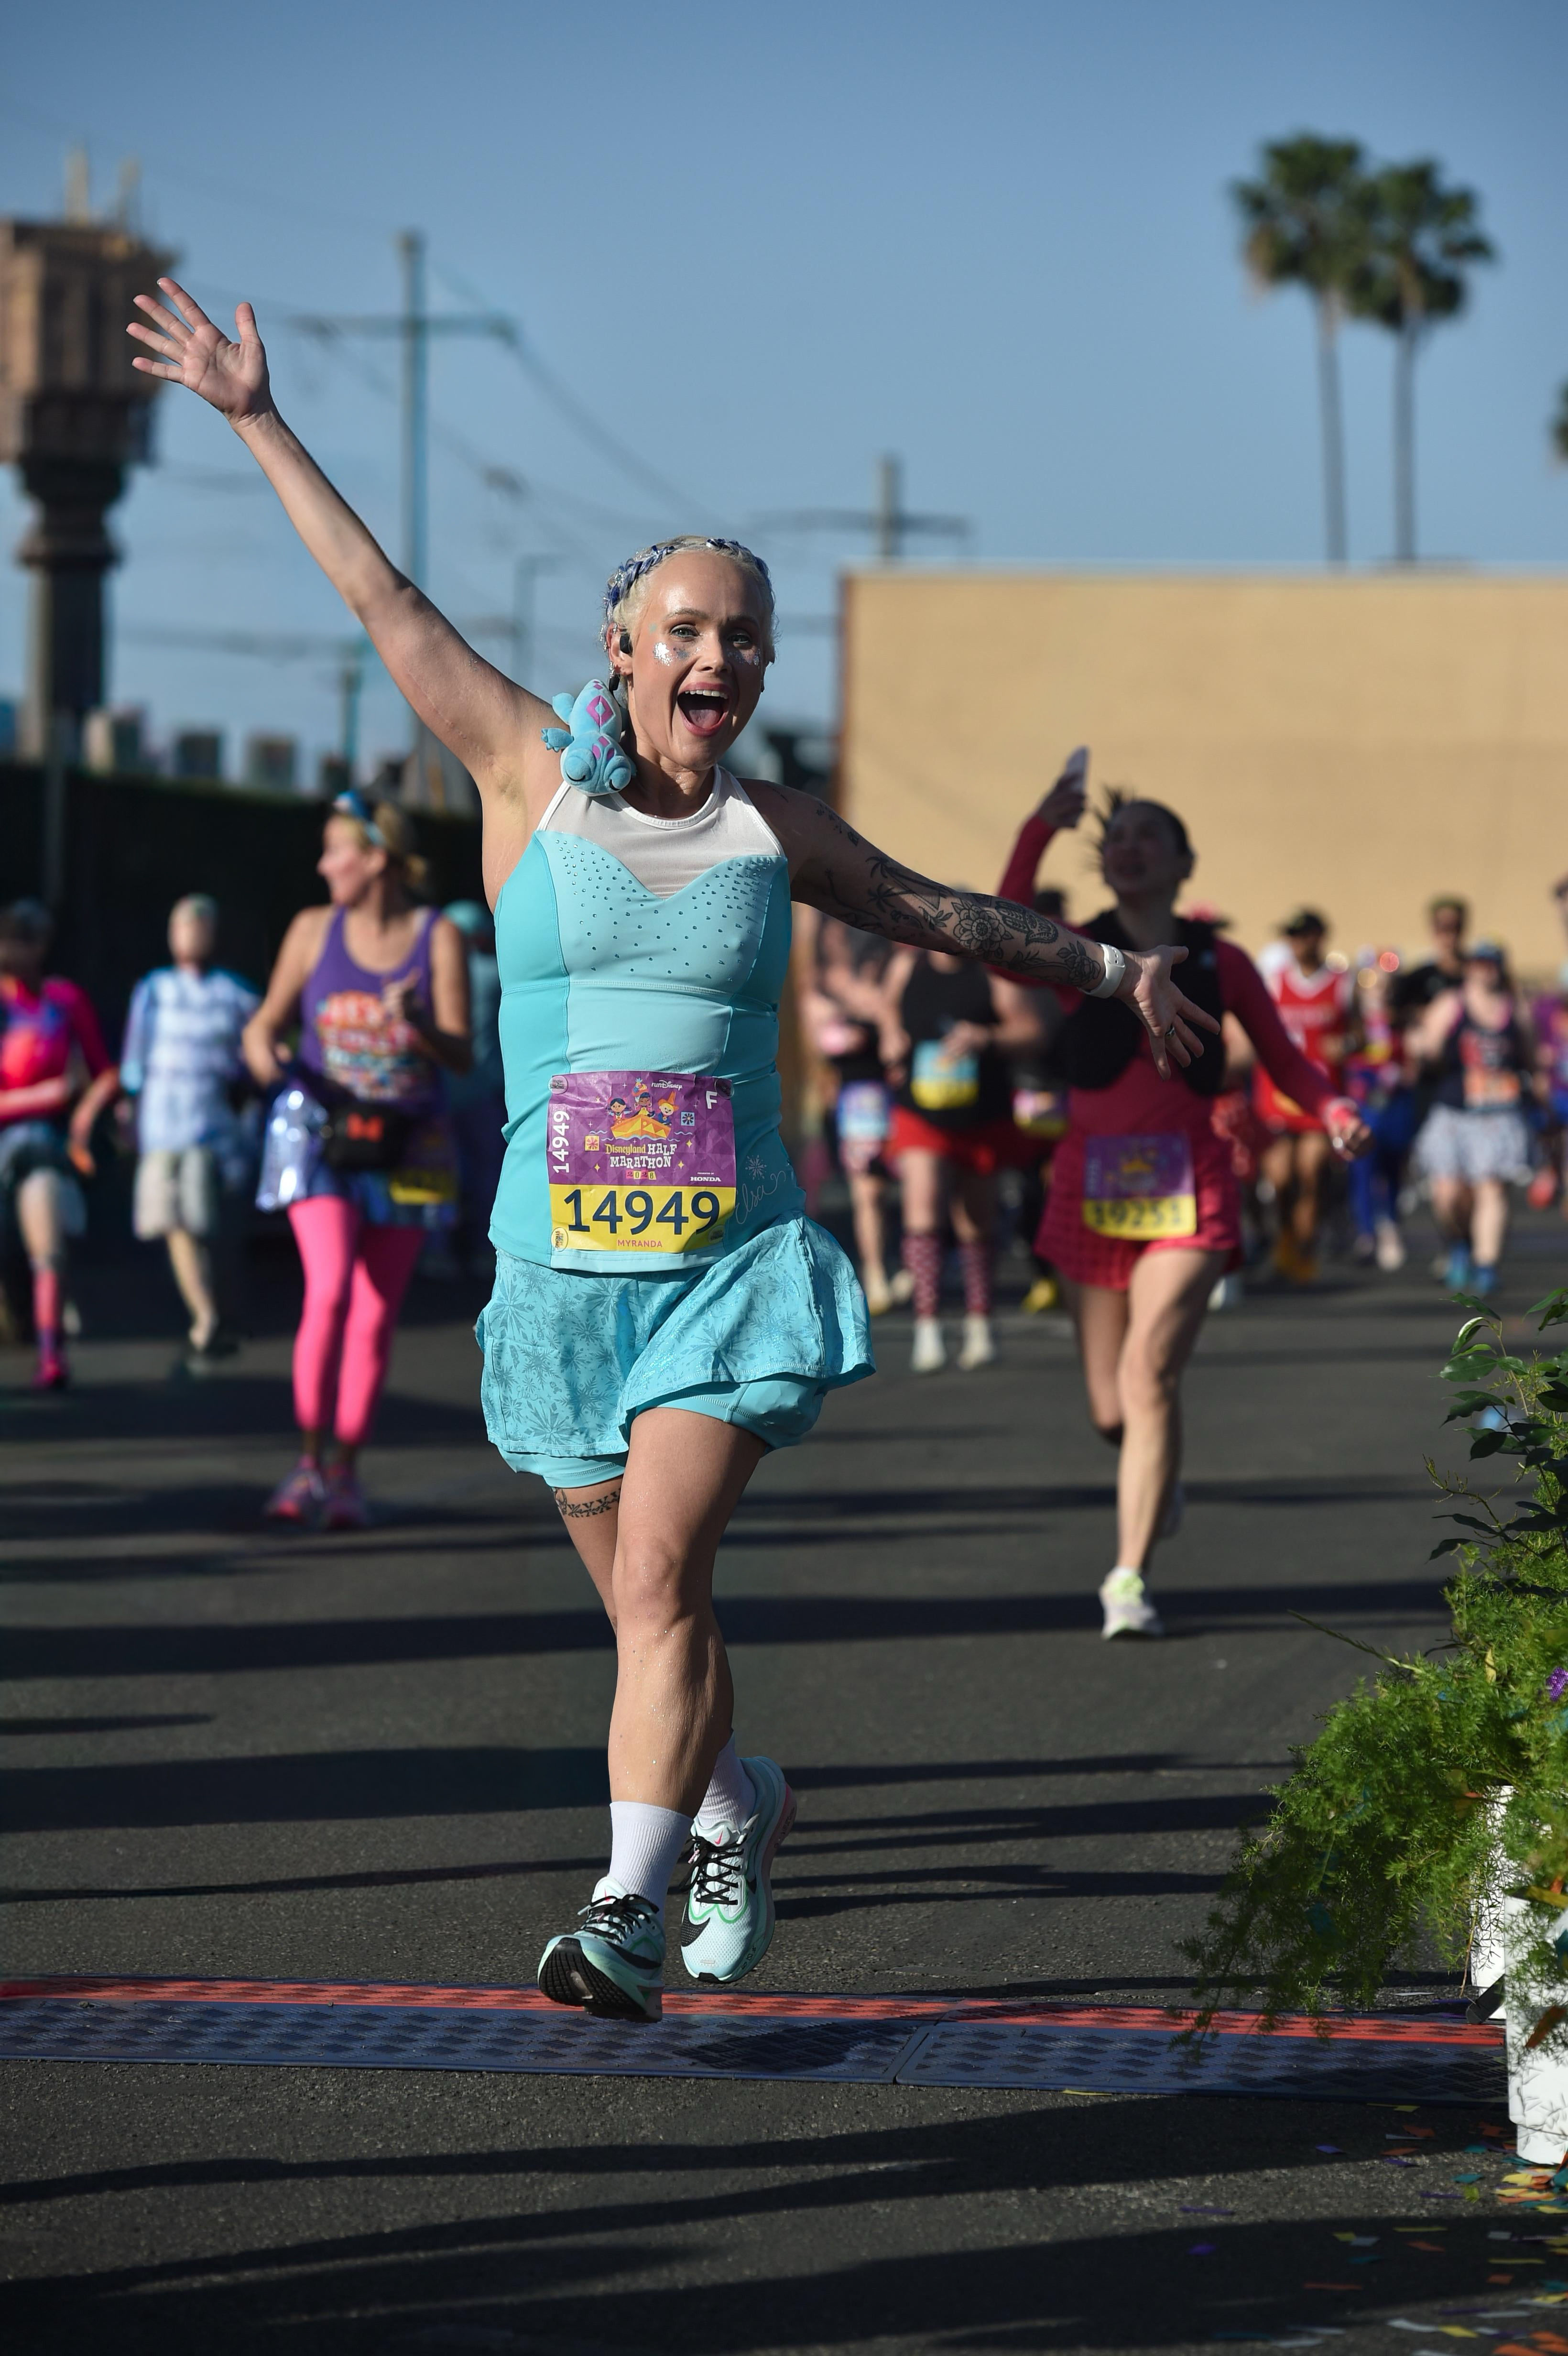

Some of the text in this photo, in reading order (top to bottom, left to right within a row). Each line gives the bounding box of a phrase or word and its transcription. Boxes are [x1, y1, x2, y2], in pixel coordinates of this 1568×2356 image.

[651, 1080, 683, 1091] runDisney
[706, 1090, 718, 1110] F
[552, 1111, 570, 1173] 14949
[604, 1143, 677, 1156] Disneyland HALF
[610, 1156, 672, 1169] MARATHON
[564, 1189, 720, 1235] 14949
[617, 1239, 663, 1248] MYRANDA
